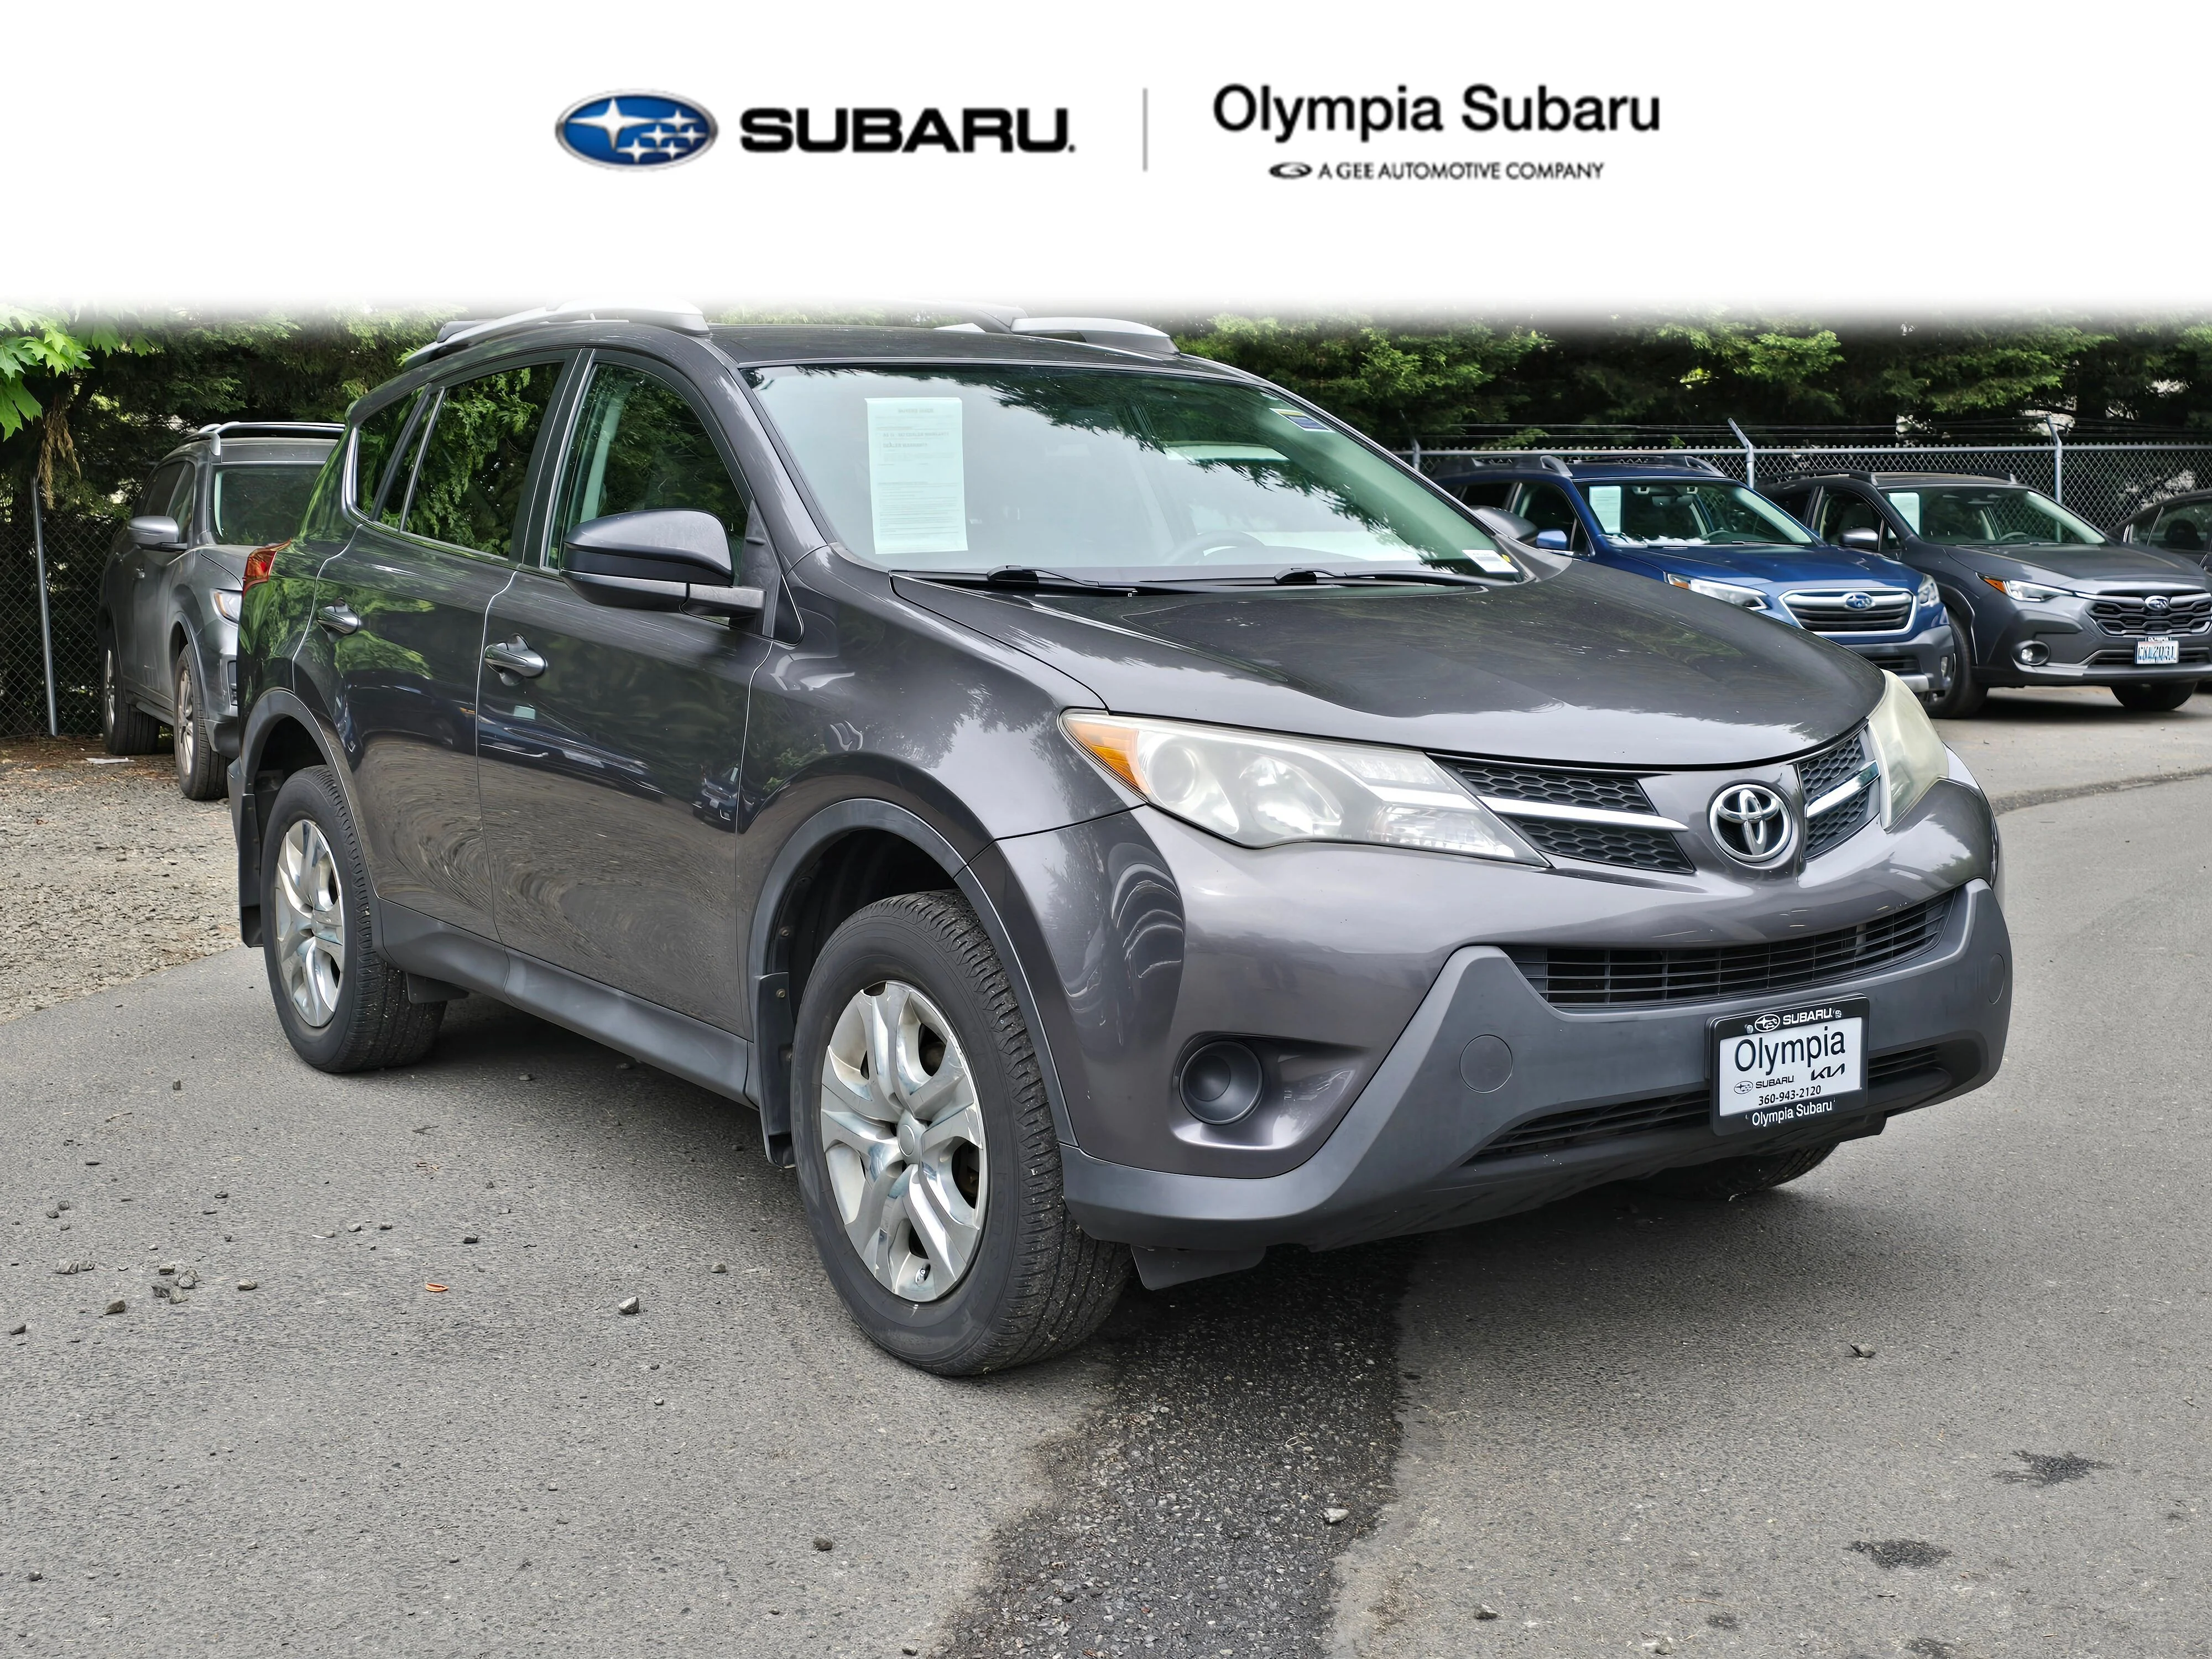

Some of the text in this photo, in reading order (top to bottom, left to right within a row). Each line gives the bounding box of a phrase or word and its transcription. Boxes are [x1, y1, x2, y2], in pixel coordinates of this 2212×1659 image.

[1782, 1008, 1832, 1025] SUBARU
[1734, 1026, 1846, 1076] Olympia
[1755, 1075, 1794, 1089] SUBARU
[1759, 1085, 1822, 1106] 360-943-2120
[1752, 1101, 1833, 1127] Olympia Subaru
